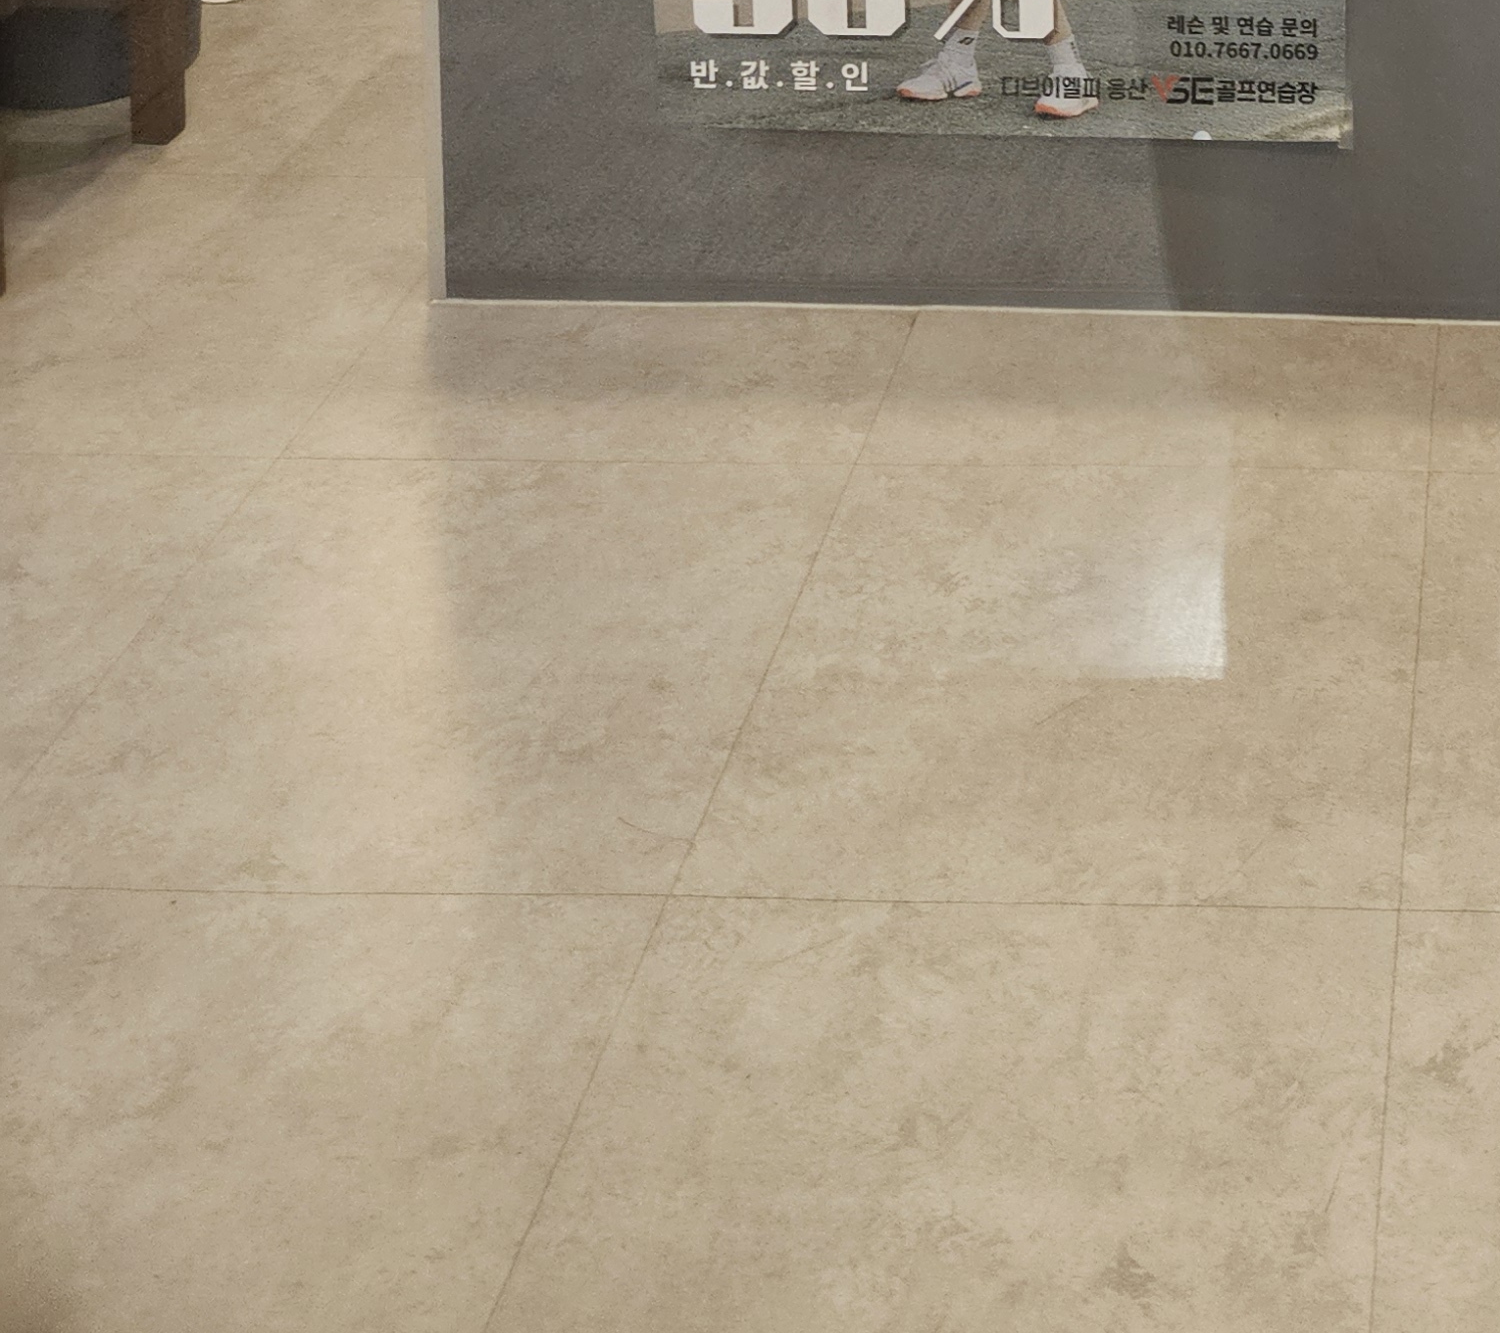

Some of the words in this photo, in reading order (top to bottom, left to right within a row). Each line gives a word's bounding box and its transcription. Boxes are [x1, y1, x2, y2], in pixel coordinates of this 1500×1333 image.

[1167, 15, 1205, 35] 레슨
[1211, 15, 1230, 35] 및
[1237, 16, 1276, 37] 연습
[1281, 17, 1319, 38] 문의
[1169, 40, 1319, 61] 010.7667.0669
[1000, 75, 1100, 101] 디브이엘피
